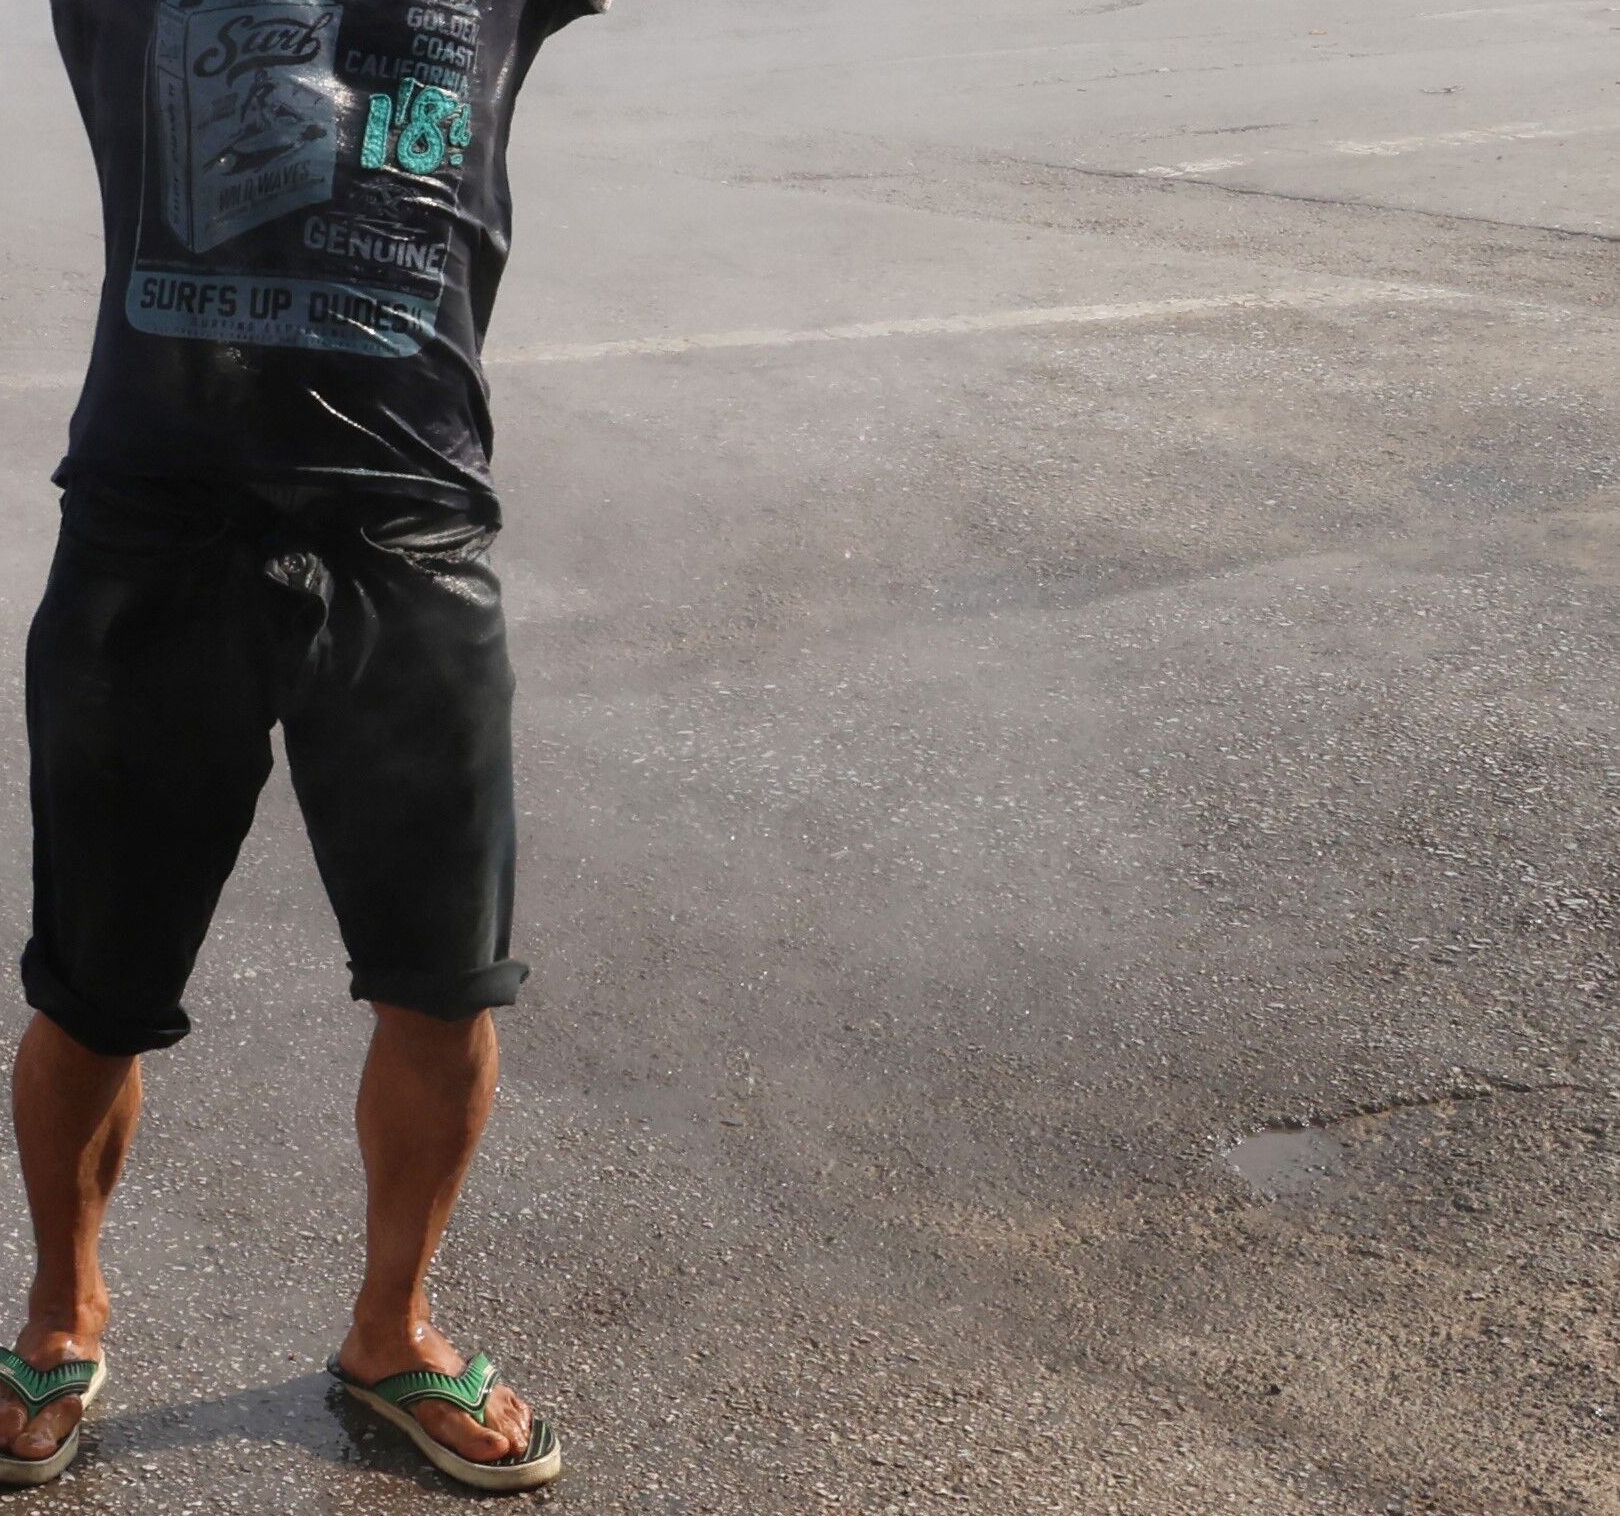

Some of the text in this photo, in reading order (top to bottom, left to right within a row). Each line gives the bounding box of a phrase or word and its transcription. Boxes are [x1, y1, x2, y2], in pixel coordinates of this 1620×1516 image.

[193, 11, 335, 88] Surf
[411, 34, 474, 70] COAST
[302, 215, 448, 275] GENUINE
[139, 277, 239, 318] SURFS
[249, 287, 293, 322] UP
